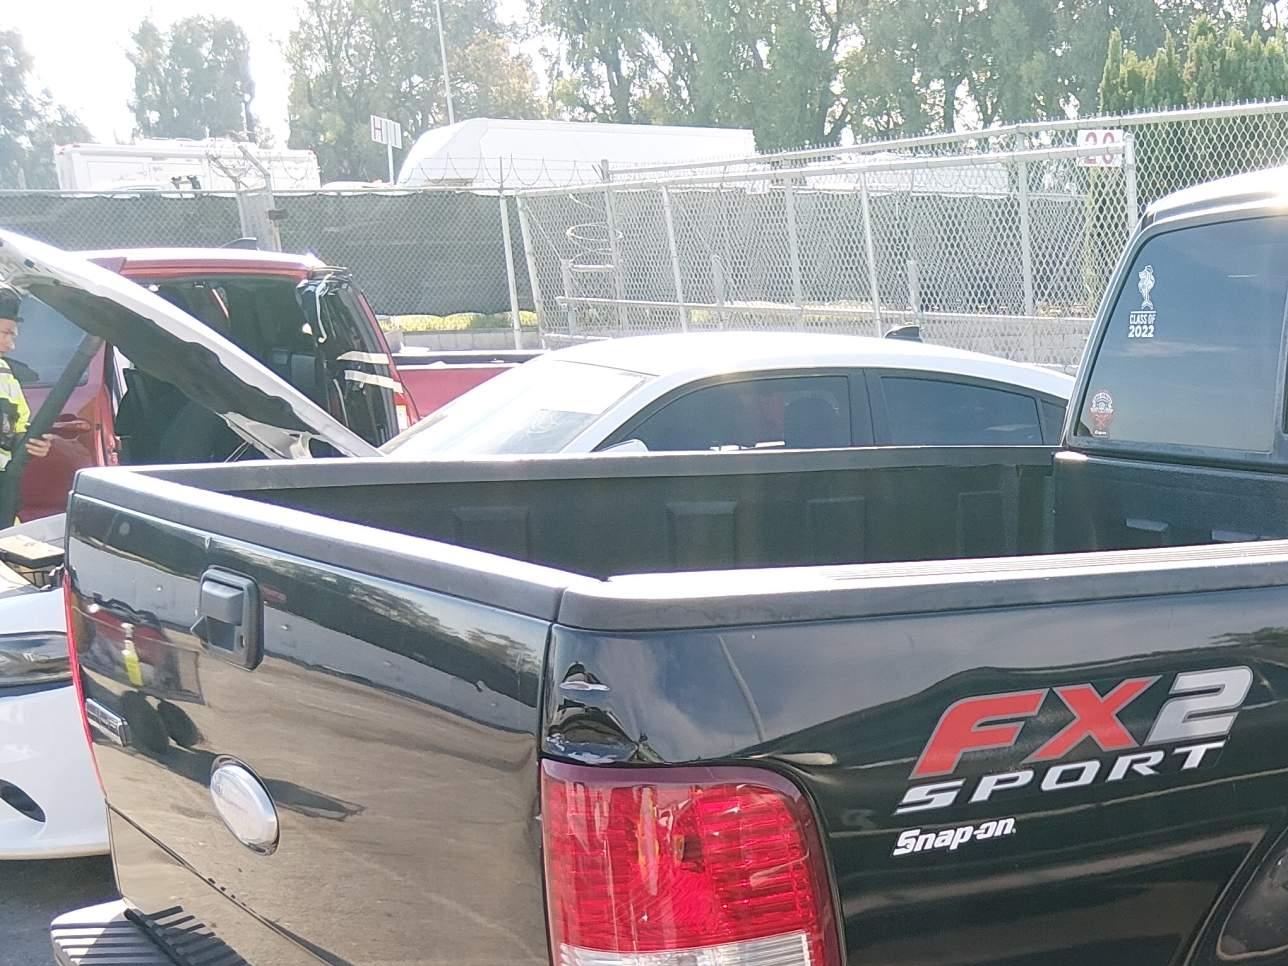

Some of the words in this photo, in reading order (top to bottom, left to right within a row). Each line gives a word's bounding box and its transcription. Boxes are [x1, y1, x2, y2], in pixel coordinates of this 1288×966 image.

[1127, 325, 1155, 338] 2022
[1130, 314, 1148, 325] CLASS
[909, 665, 1254, 780] FX2
[893, 740, 1227, 815] SPORT
